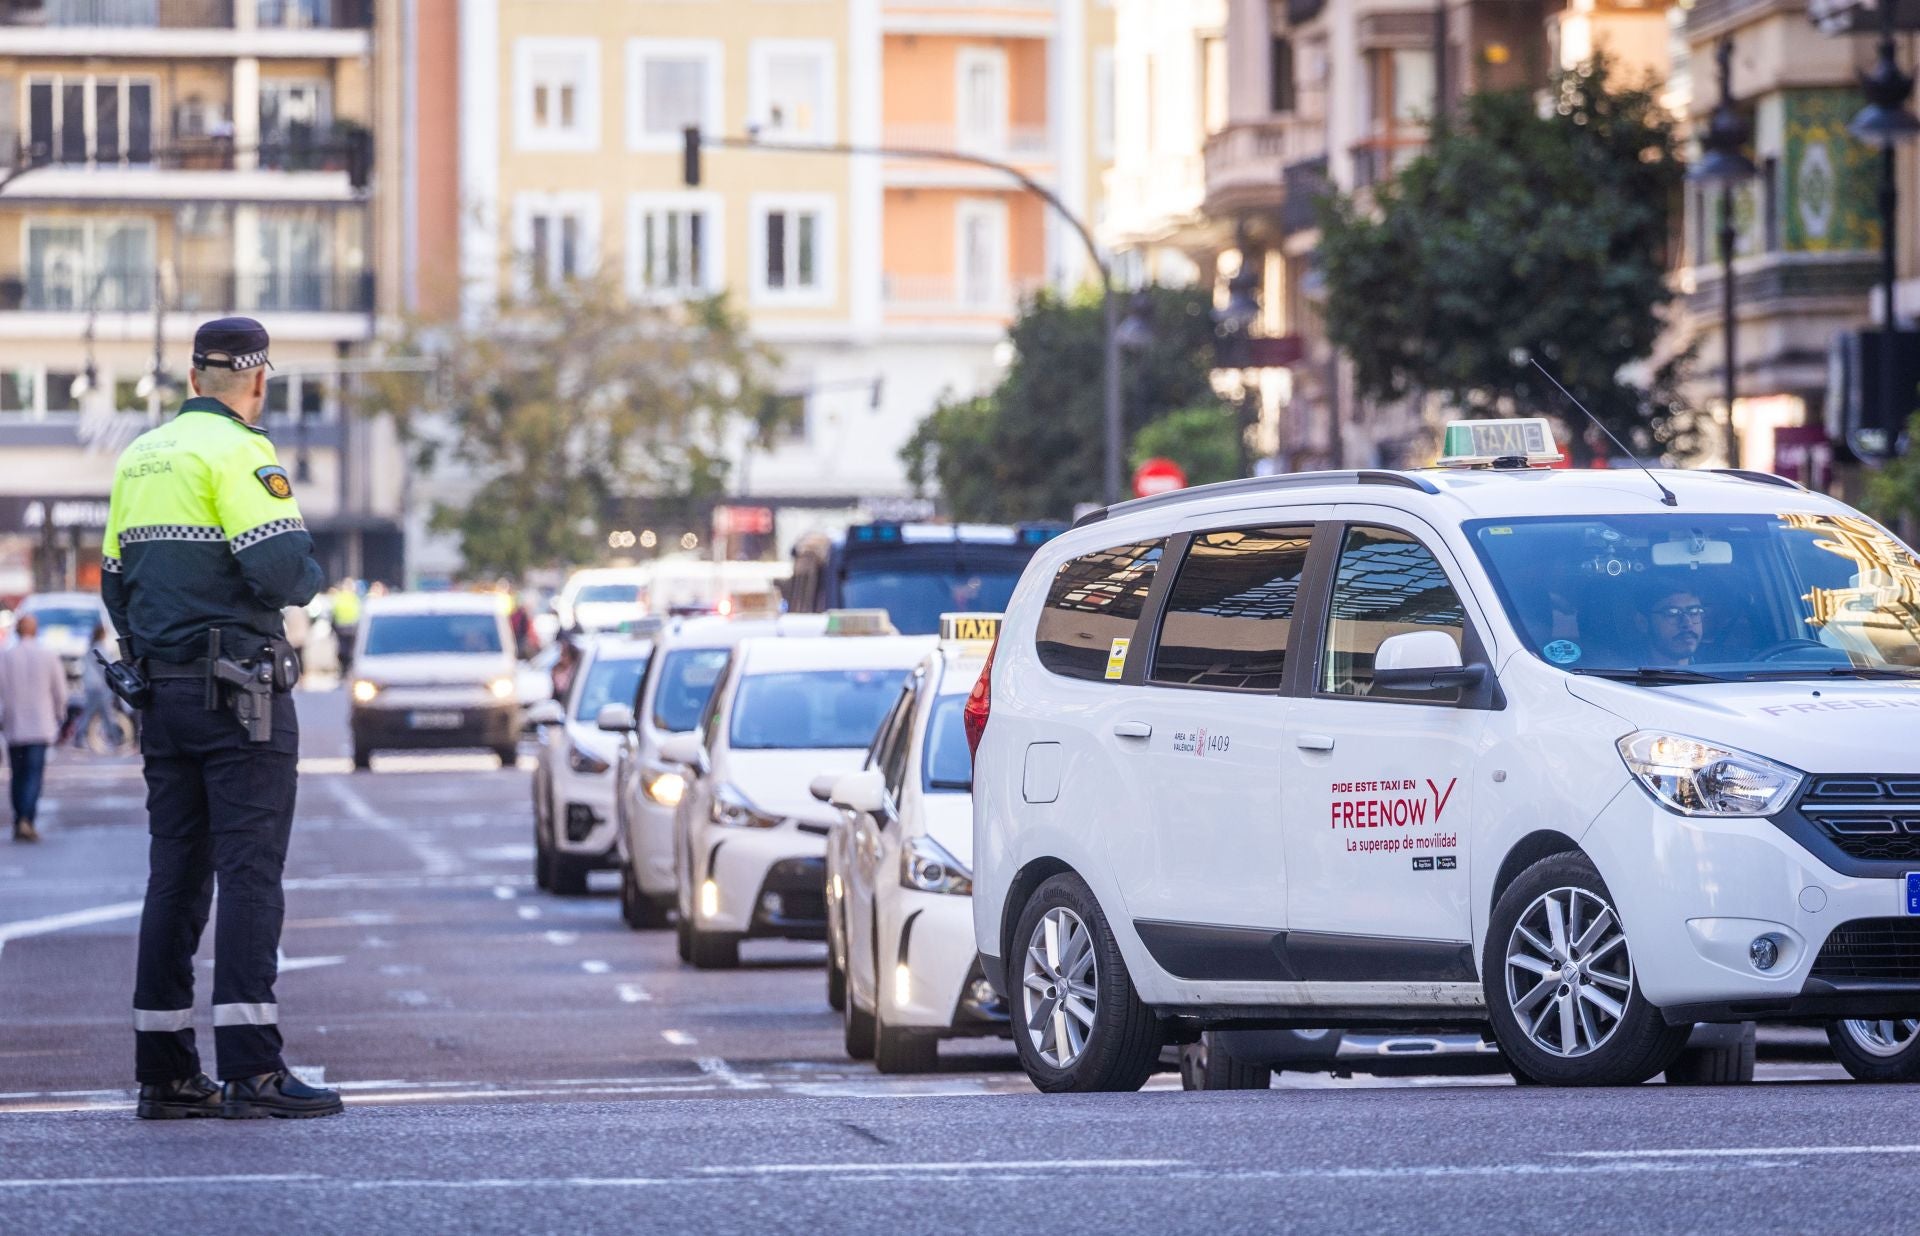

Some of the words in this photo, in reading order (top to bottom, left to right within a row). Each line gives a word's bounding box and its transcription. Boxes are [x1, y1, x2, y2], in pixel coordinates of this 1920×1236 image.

[1474, 426, 1523, 451] TAXI
[122, 460, 173, 480] VALENCIA
[956, 620, 996, 639] TAXI
[1190, 733, 1196, 742] DE
[1208, 735, 1230, 751] 1409
[1332, 783, 1353, 793] PIDE
[1355, 782, 1378, 792] ESTE
[1380, 780, 1401, 791] TAXI
[1403, 780, 1416, 790] EN
[1331, 798, 1427, 829] FREENOW
[1346, 838, 1357, 852] La
[1360, 838, 1400, 854] superapp
[1403, 834, 1414, 849] de
[1416, 833, 1457, 849] movilidad
[1912, 898, 1918, 907] E
